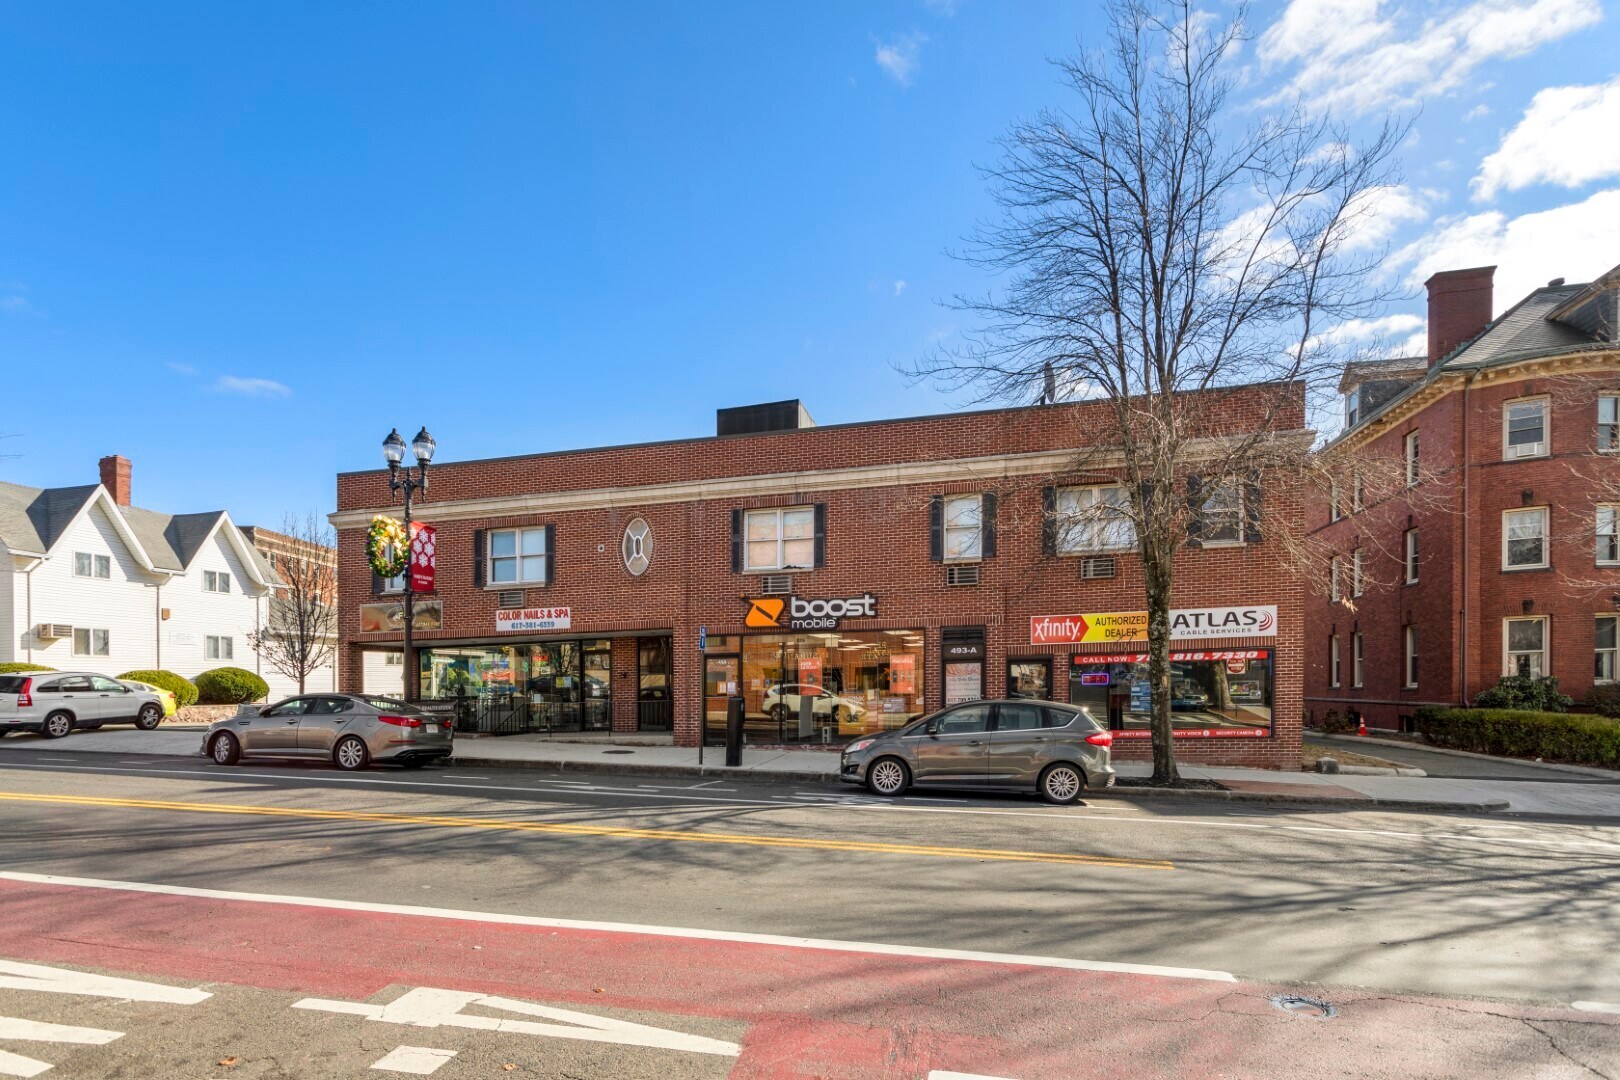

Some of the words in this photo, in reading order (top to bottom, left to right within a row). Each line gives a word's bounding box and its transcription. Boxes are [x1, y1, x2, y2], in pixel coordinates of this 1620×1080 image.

[790, 594, 876, 617] boost
[498, 611, 522, 621] COLOR
[523, 609, 545, 620] NAILS
[546, 609, 553, 619] &
[553, 608, 569, 619] SPA
[1172, 610, 1257, 629] ATLAS
[791, 618, 836, 629] mobile
[1095, 615, 1147, 626] AUTHORIZED
[1034, 618, 1081, 641] xfinity
[1105, 628, 1138, 638] DEALER
[1210, 627, 1252, 635] SERVICES
[950, 646, 977, 654] 493-A
[1082, 656, 1105, 664] CALL
[1107, 655, 1131, 663] NOW:
